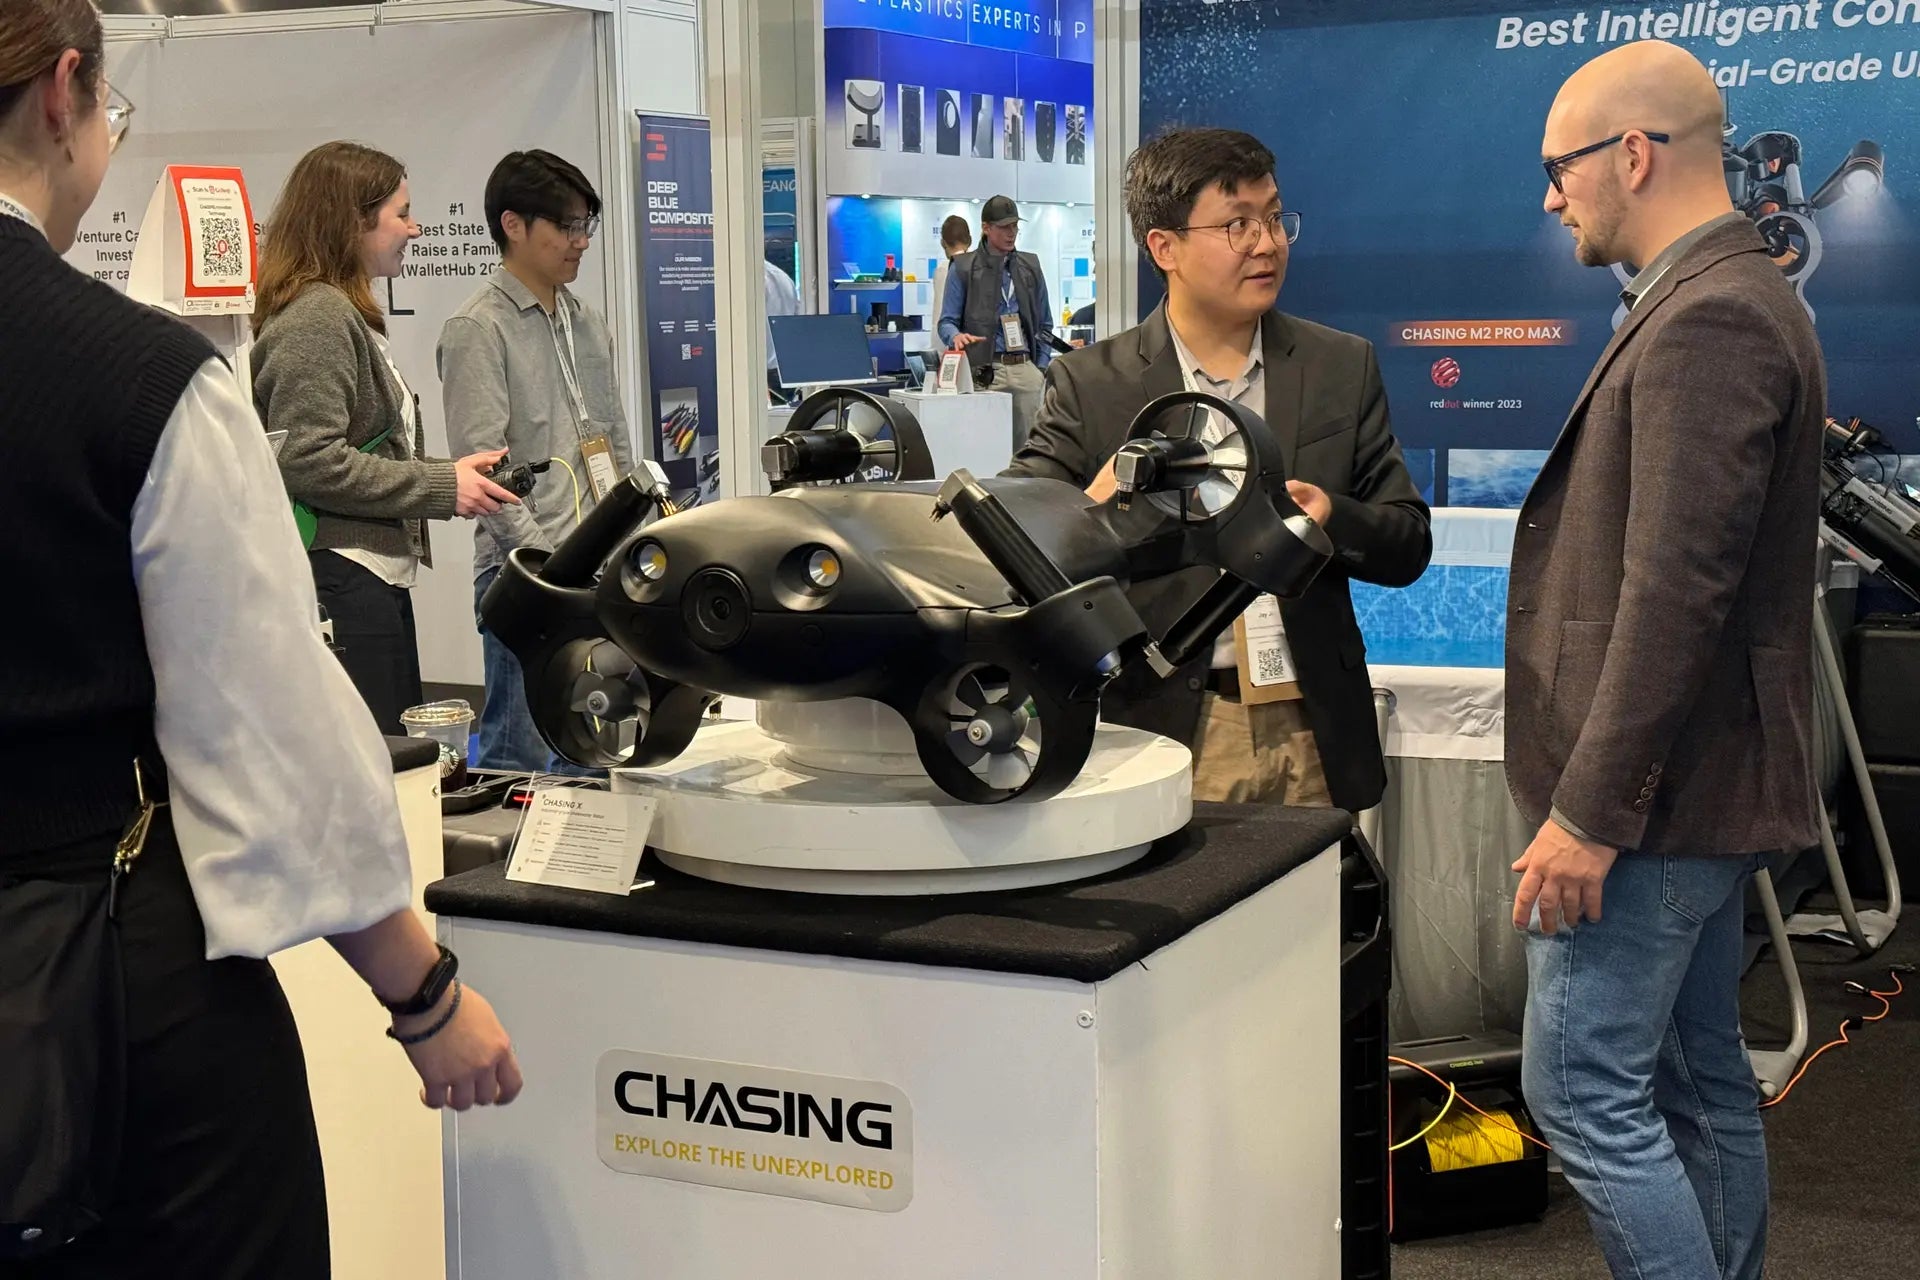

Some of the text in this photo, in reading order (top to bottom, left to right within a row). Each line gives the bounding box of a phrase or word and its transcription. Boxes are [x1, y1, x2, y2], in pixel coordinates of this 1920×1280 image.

[878, 0, 963, 20] LASTICS
[972, 3, 1041, 34] EXPERTS
[1048, 18, 1062, 37] IN
[1496, 10, 1588, 49] Best
[1596, 0, 1822, 47] Intelligent
[1892, 51, 1920, 79] U
[647, 181, 678, 193] DEEP
[648, 196, 679, 209] BLUE
[449, 203, 464, 216] #1
[113, 211, 126, 223] #1
[649, 212, 714, 225] COMPOSITE
[448, 223, 484, 236] State
[76, 230, 122, 243] Venture
[96, 249, 133, 261] Invest
[411, 243, 448, 257] Raise
[451, 247, 459, 256] a
[94, 270, 114, 280] per
[401, 263, 502, 279] (WalletHub 20
[1401, 326, 1562, 340] CHASING M2 PRO MAX
[1463, 399, 1495, 409] winner
[1497, 399, 1522, 409] 2023
[543, 798, 576, 809] CHASING
[614, 1070, 893, 1150] CHASING
[614, 1133, 894, 1190] EXPLORE THE UNEXPLORED
